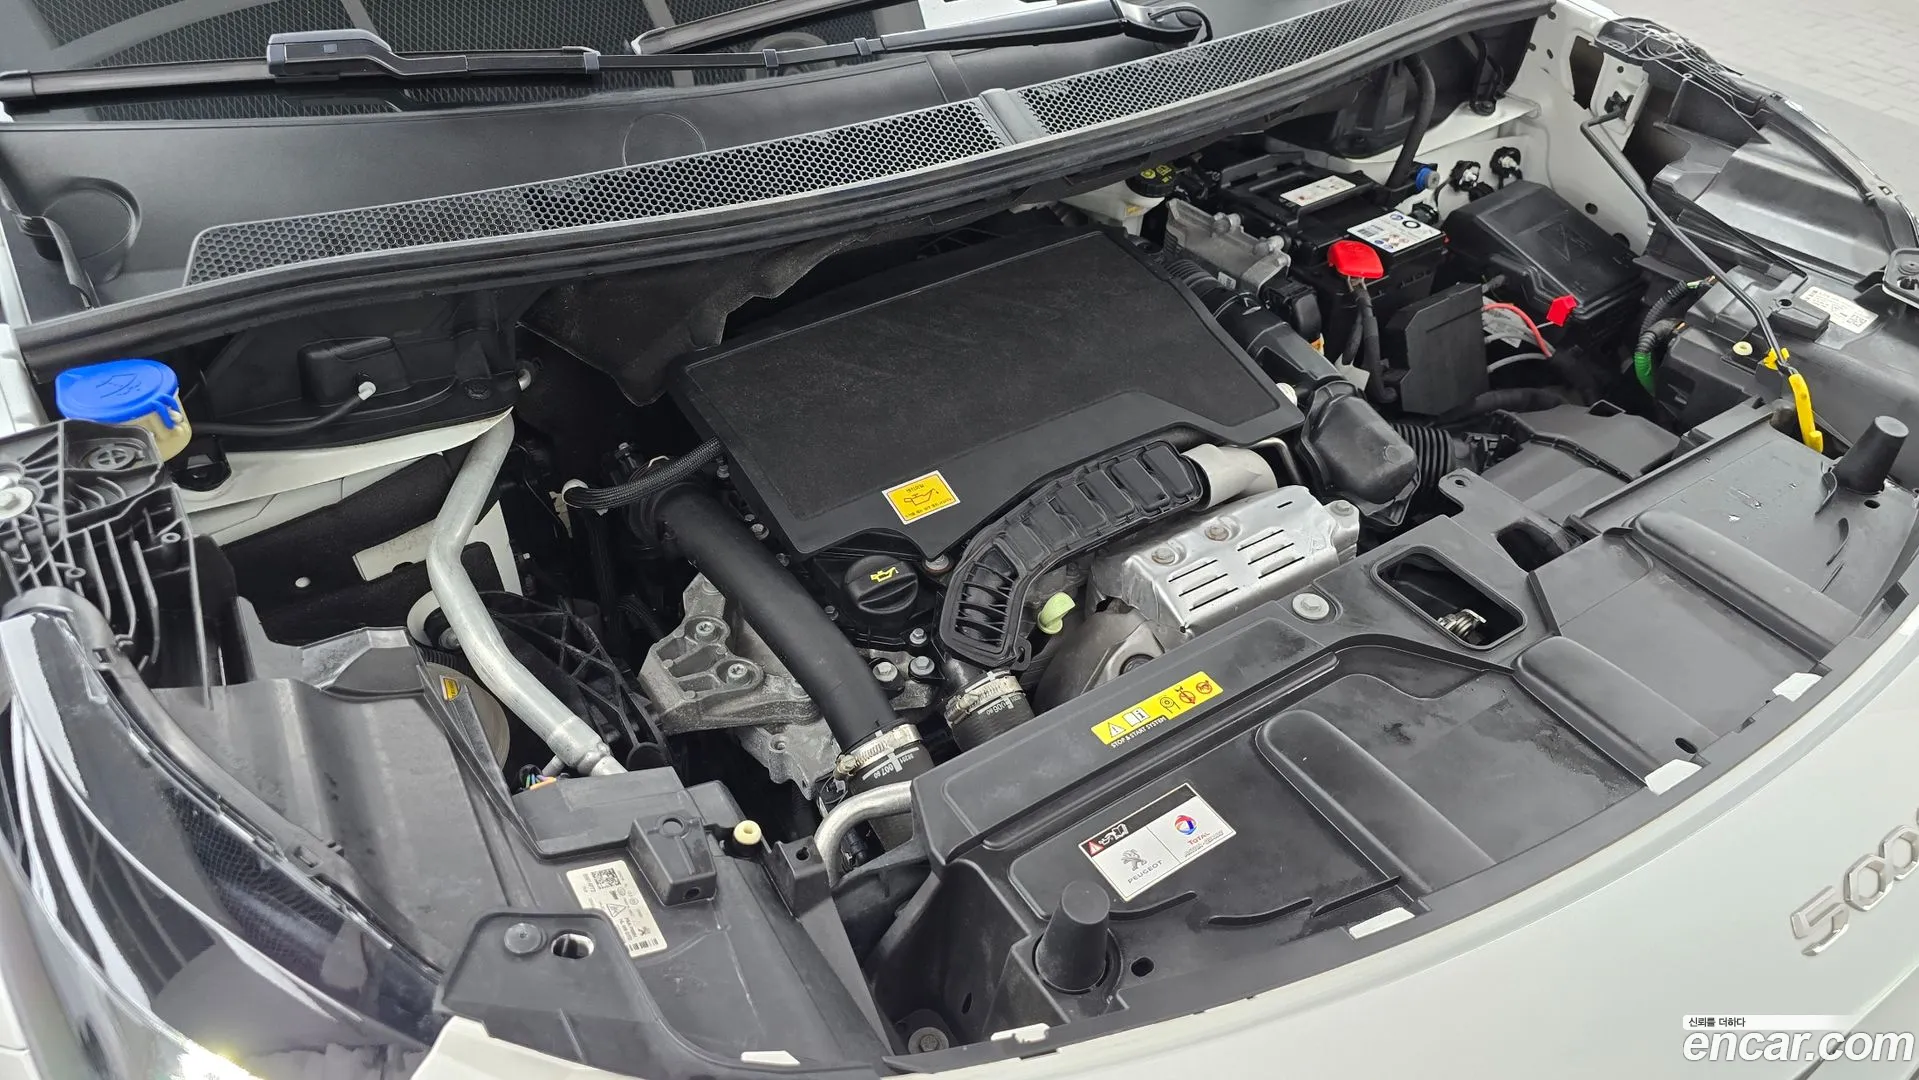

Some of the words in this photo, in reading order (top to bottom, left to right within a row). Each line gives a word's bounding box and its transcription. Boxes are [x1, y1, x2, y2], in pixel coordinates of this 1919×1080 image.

[1111, 738, 1126, 748] STOP
[1130, 727, 1146, 738] START
[1146, 717, 1167, 729] SYSTEM
[882, 764, 893, 776] 007
[1127, 859, 1164, 884] PEUGEOT
[1790, 807, 1919, 957] 500
